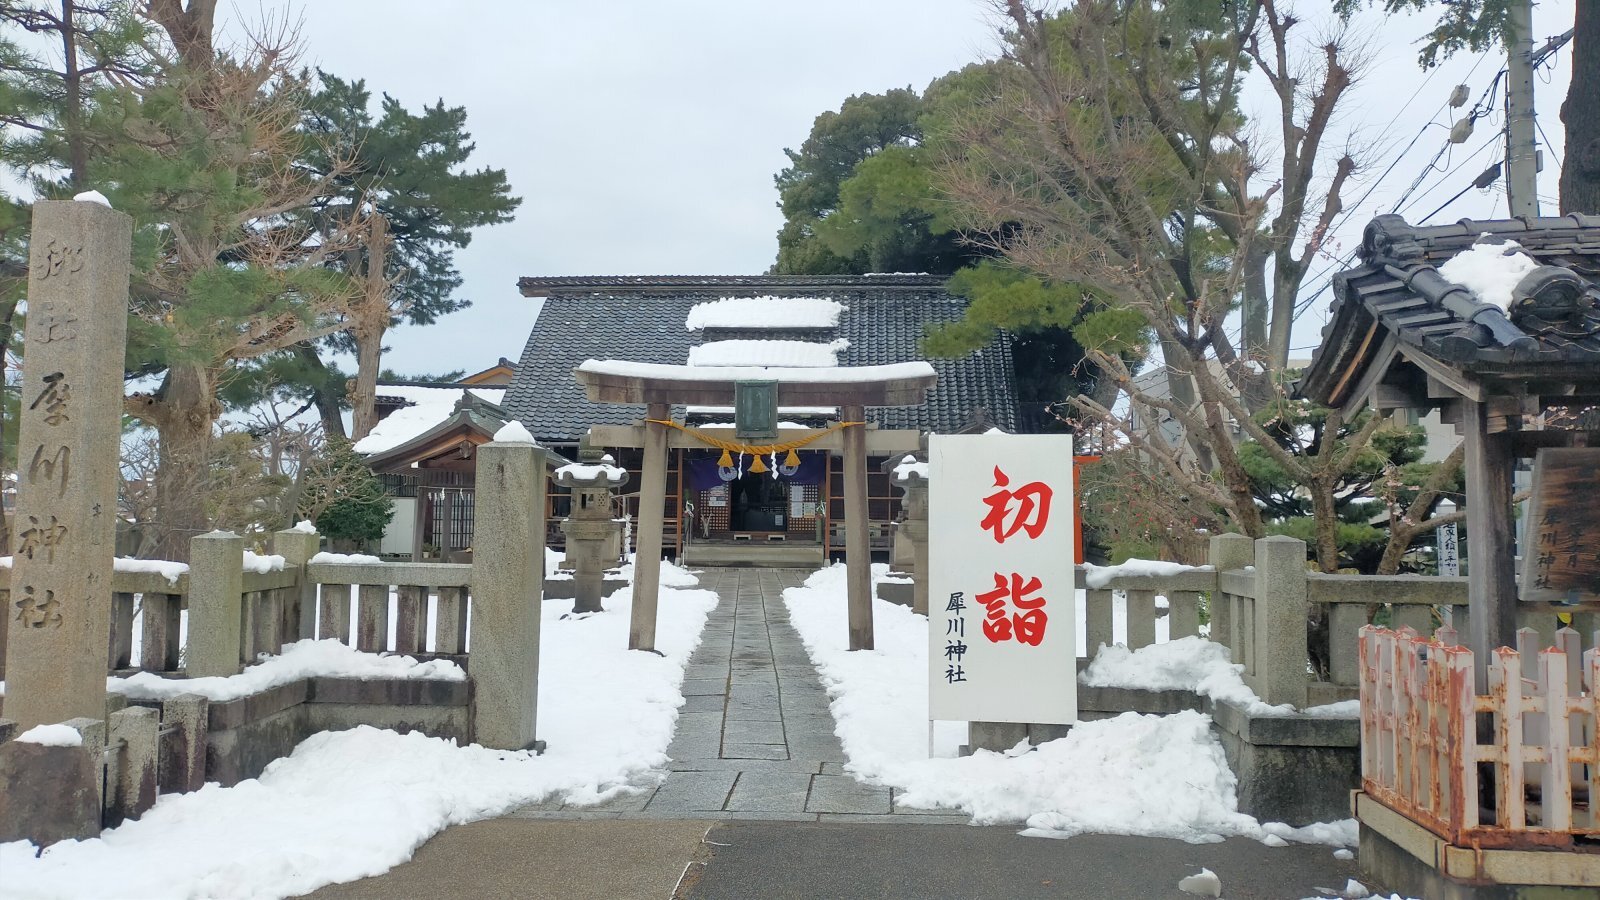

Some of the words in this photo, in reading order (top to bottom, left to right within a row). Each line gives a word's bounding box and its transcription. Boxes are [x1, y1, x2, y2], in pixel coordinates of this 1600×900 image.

[975, 465, 1053, 647] 初詣
[944, 591, 968, 684] 犀川神社
